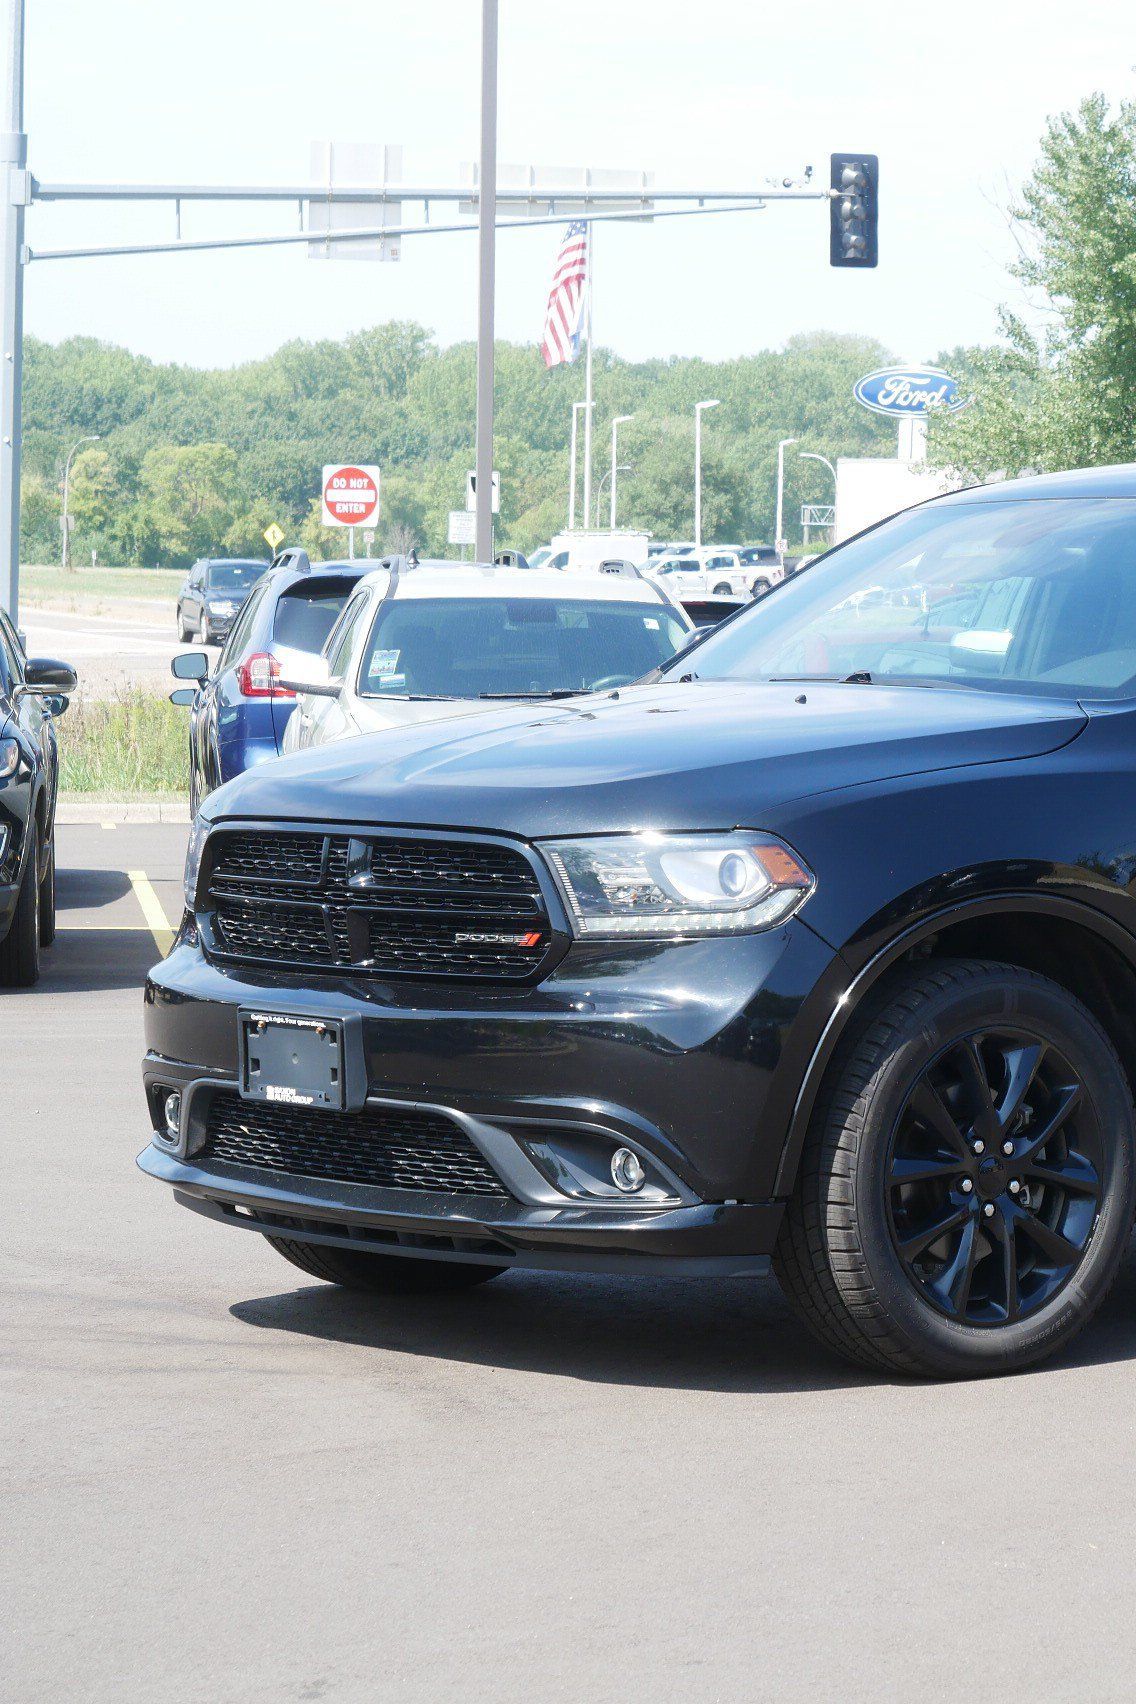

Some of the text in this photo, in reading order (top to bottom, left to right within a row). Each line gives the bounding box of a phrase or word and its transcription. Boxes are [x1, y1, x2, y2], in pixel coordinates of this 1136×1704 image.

[878, 375, 947, 406] Ford
[333, 477, 369, 489] DO NOT
[335, 502, 366, 514] ENTER
[454, 932, 530, 944] DODGE
